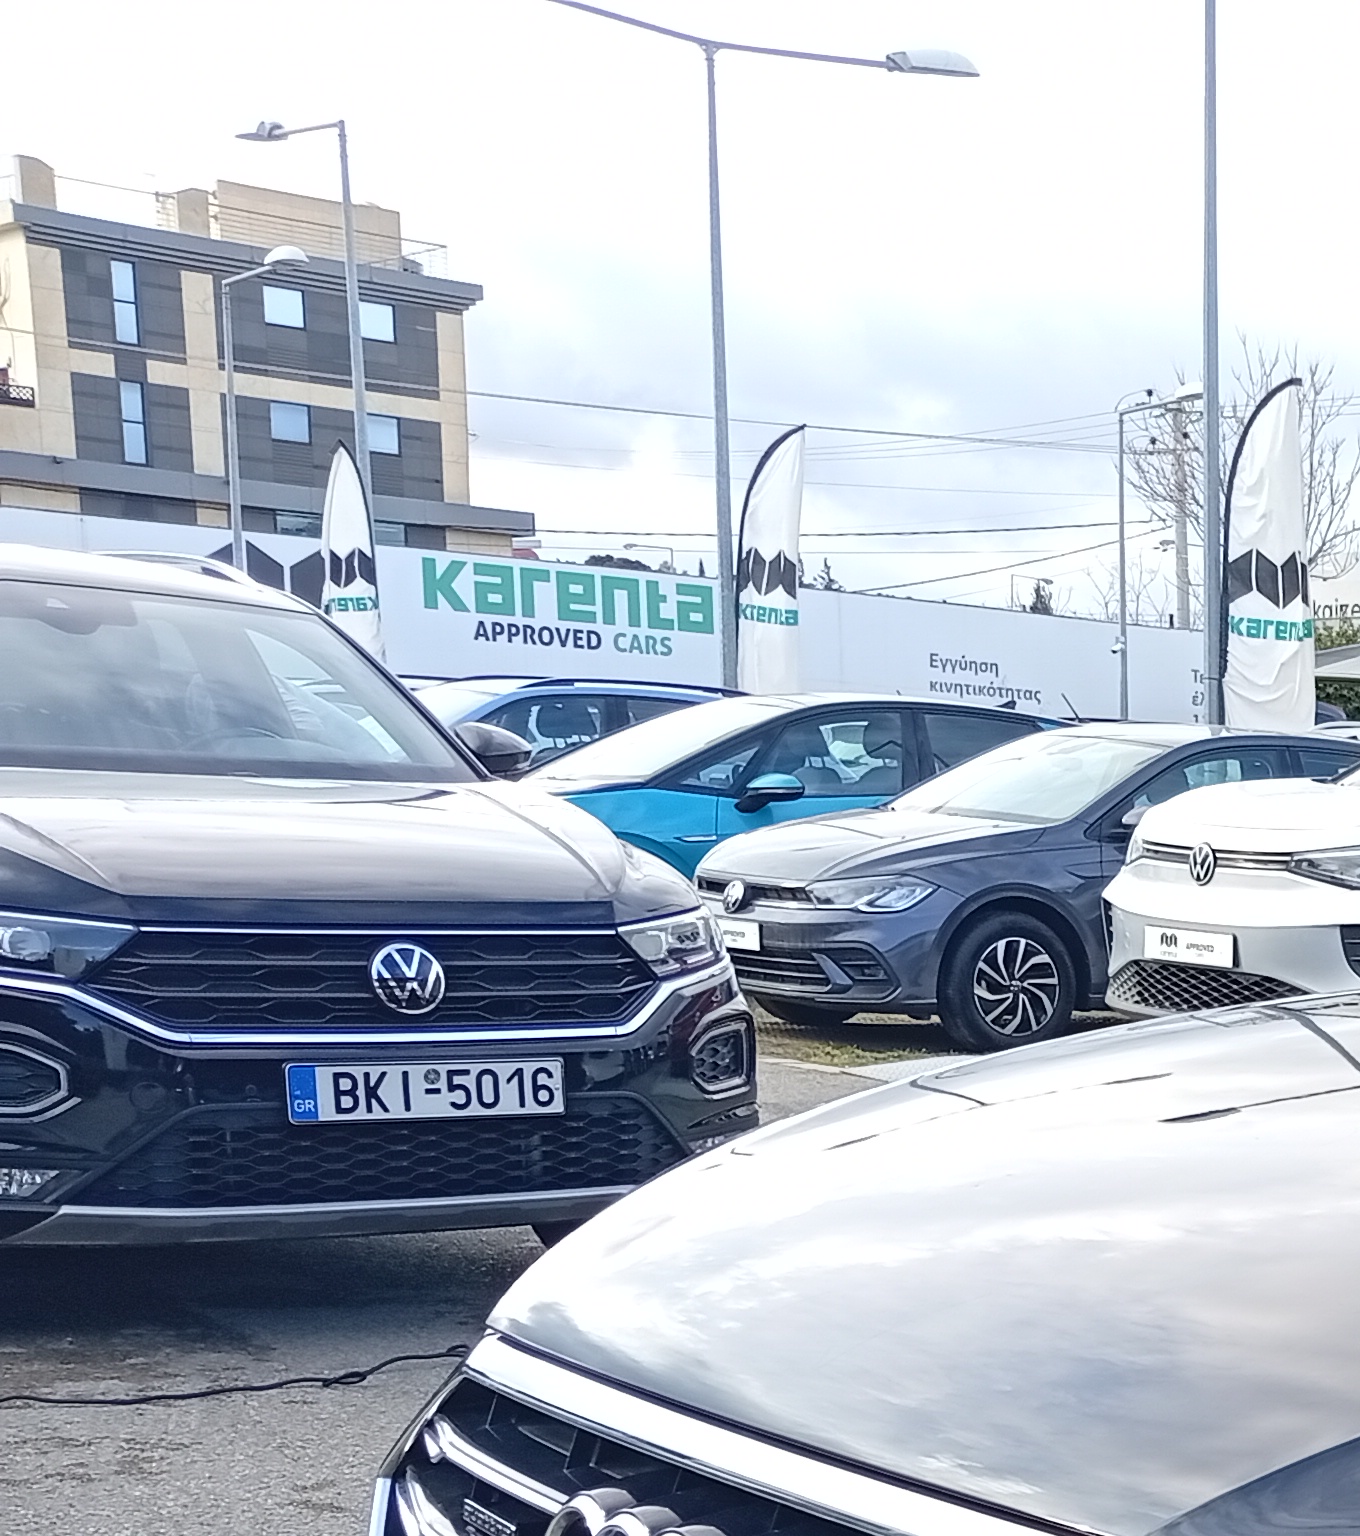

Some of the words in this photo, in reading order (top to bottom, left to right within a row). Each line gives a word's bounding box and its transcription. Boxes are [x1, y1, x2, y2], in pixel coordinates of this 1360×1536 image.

[421, 557, 715, 635] karenta
[473, 620, 602, 652] APPROVED
[612, 632, 673, 657] CARS
[929, 652, 999, 678] Εγγύηση
[929, 679, 1042, 704] κινητικότητας
[293, 1100, 316, 1113] GR
